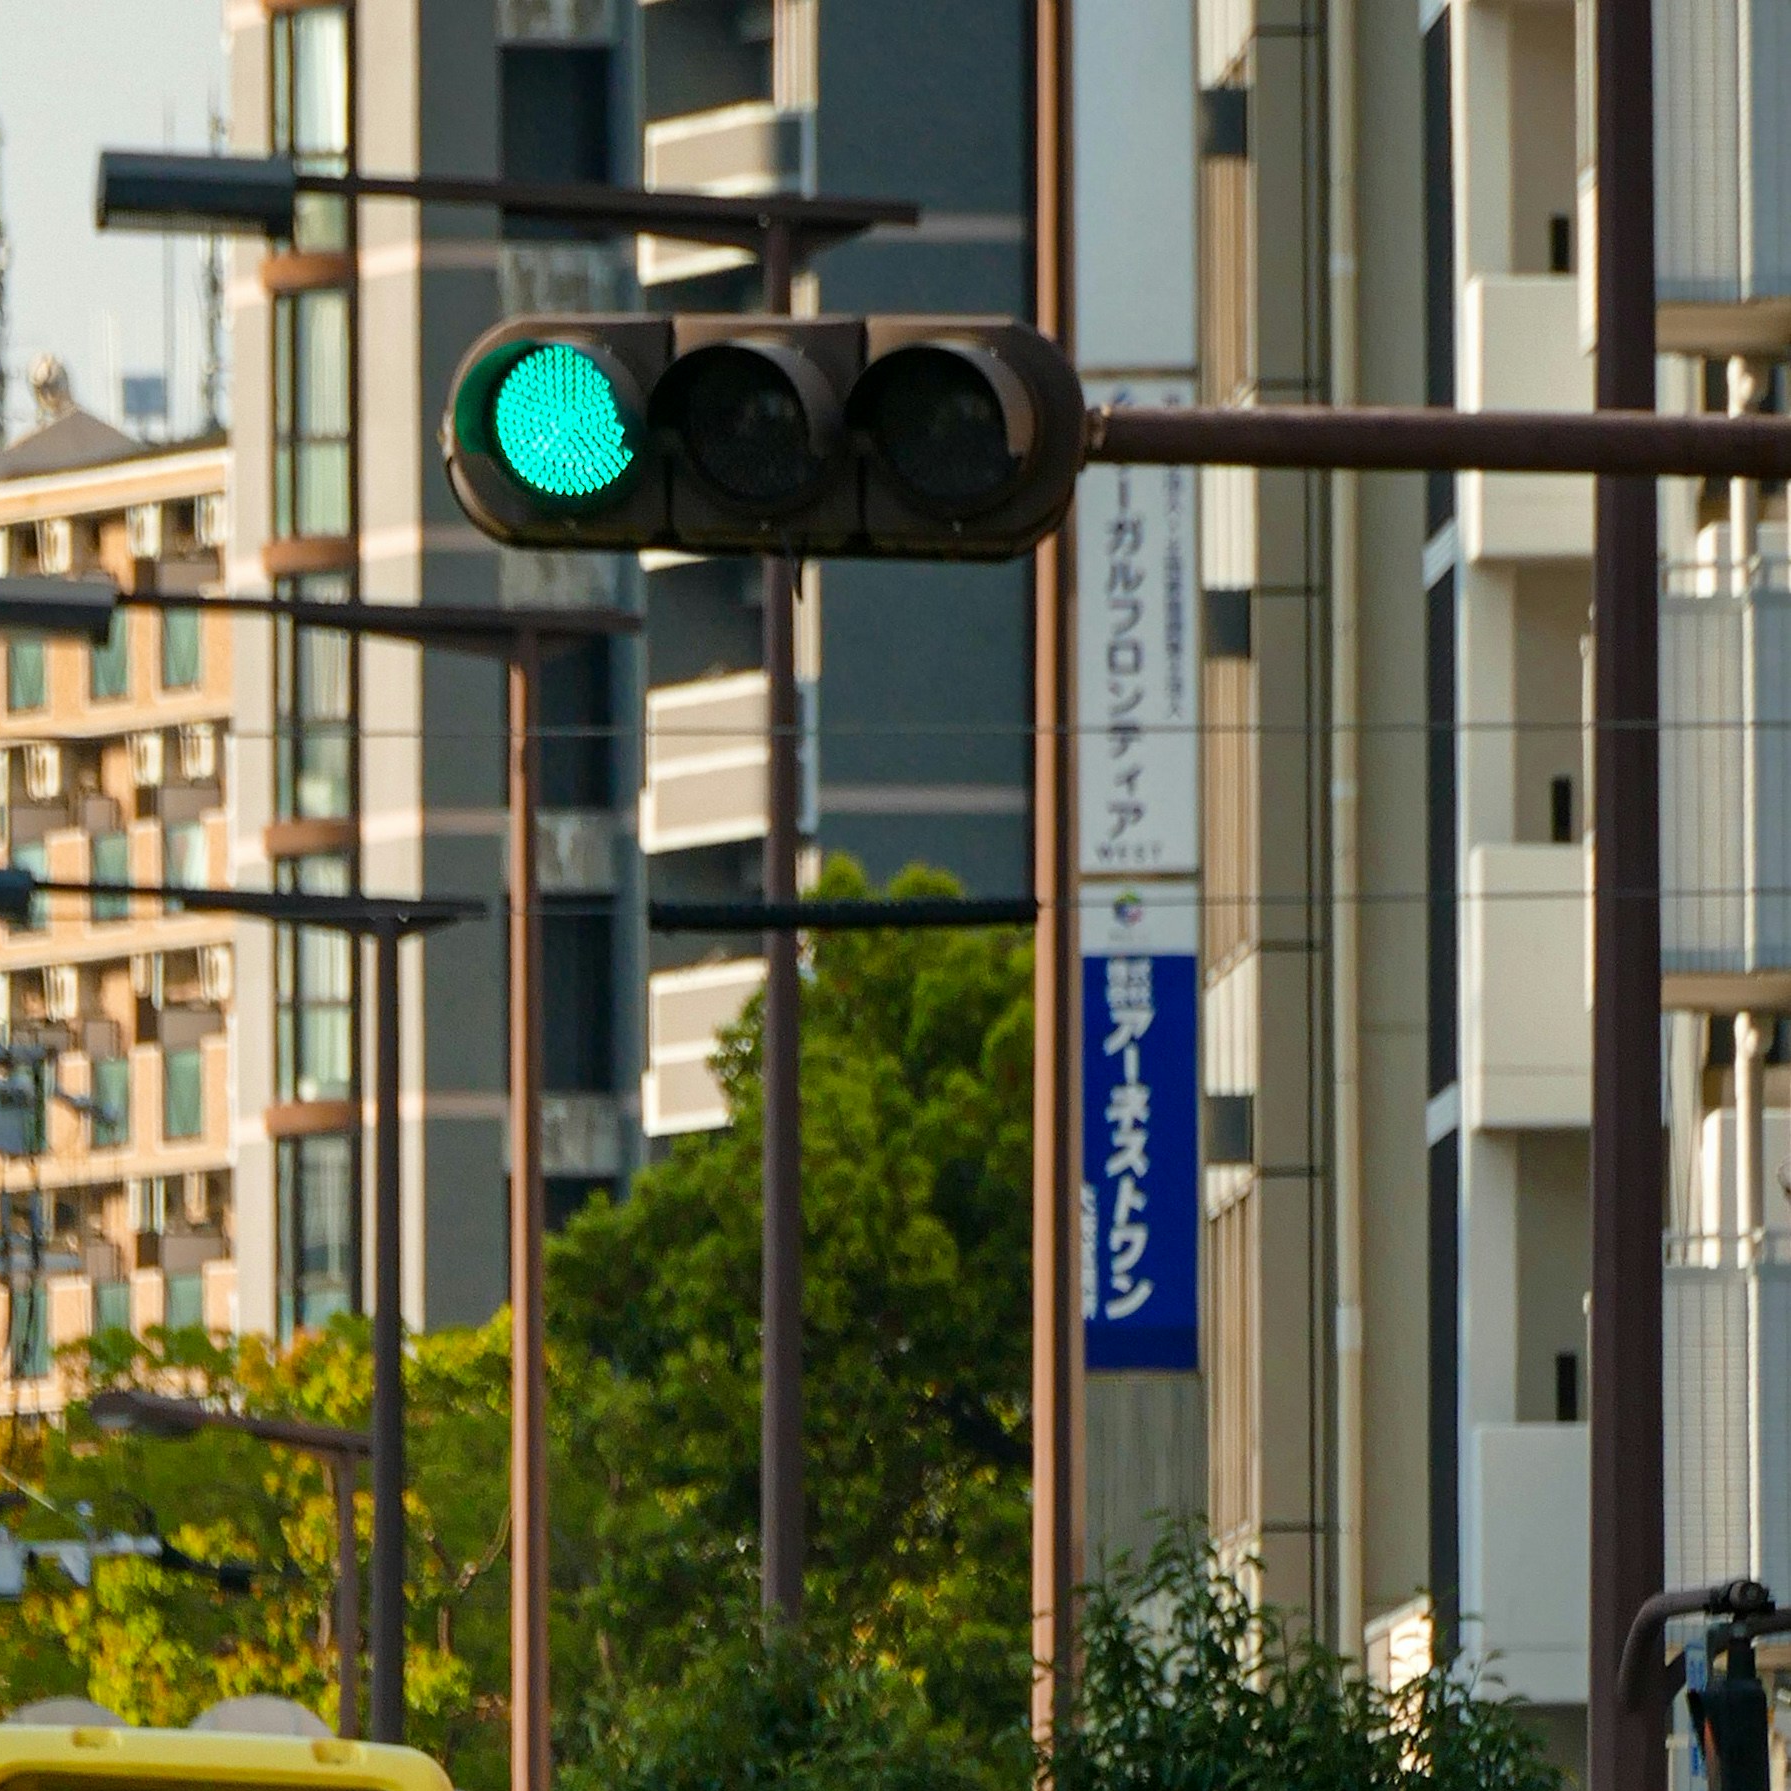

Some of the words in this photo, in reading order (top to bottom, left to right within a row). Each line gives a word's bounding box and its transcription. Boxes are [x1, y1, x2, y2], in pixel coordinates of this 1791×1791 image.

[1106, 466, 1148, 842] ーガルフロンティア
